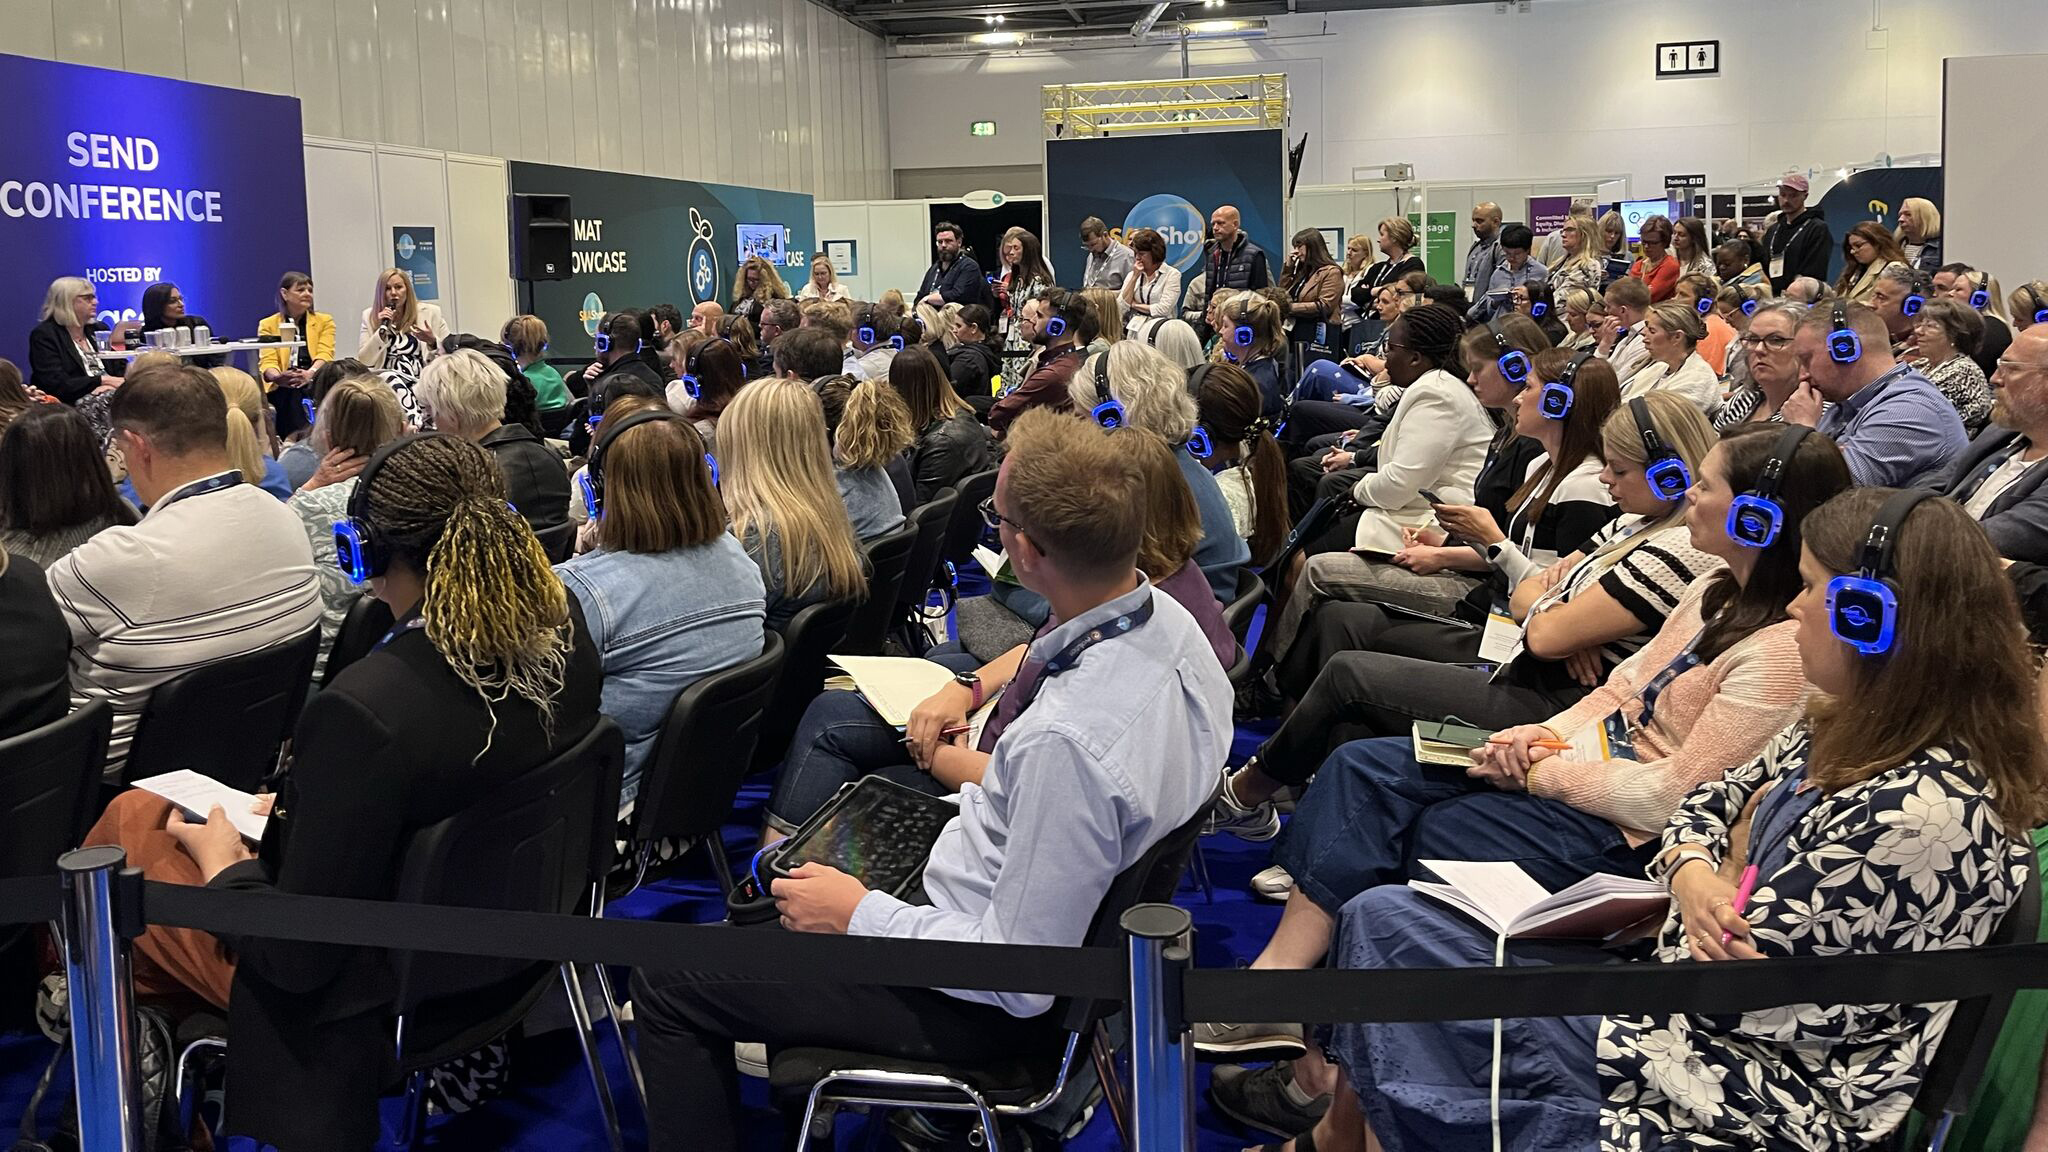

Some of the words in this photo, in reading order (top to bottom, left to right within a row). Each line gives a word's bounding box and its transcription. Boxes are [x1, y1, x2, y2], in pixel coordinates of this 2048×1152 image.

[67, 131, 159, 171] SEND
[1666, 178, 1687, 186] Toilets
[0, 180, 223, 223] CONFERENCE
[574, 219, 602, 241] MAT
[86, 268, 141, 283] HOSTED
[144, 267, 161, 282] BY
